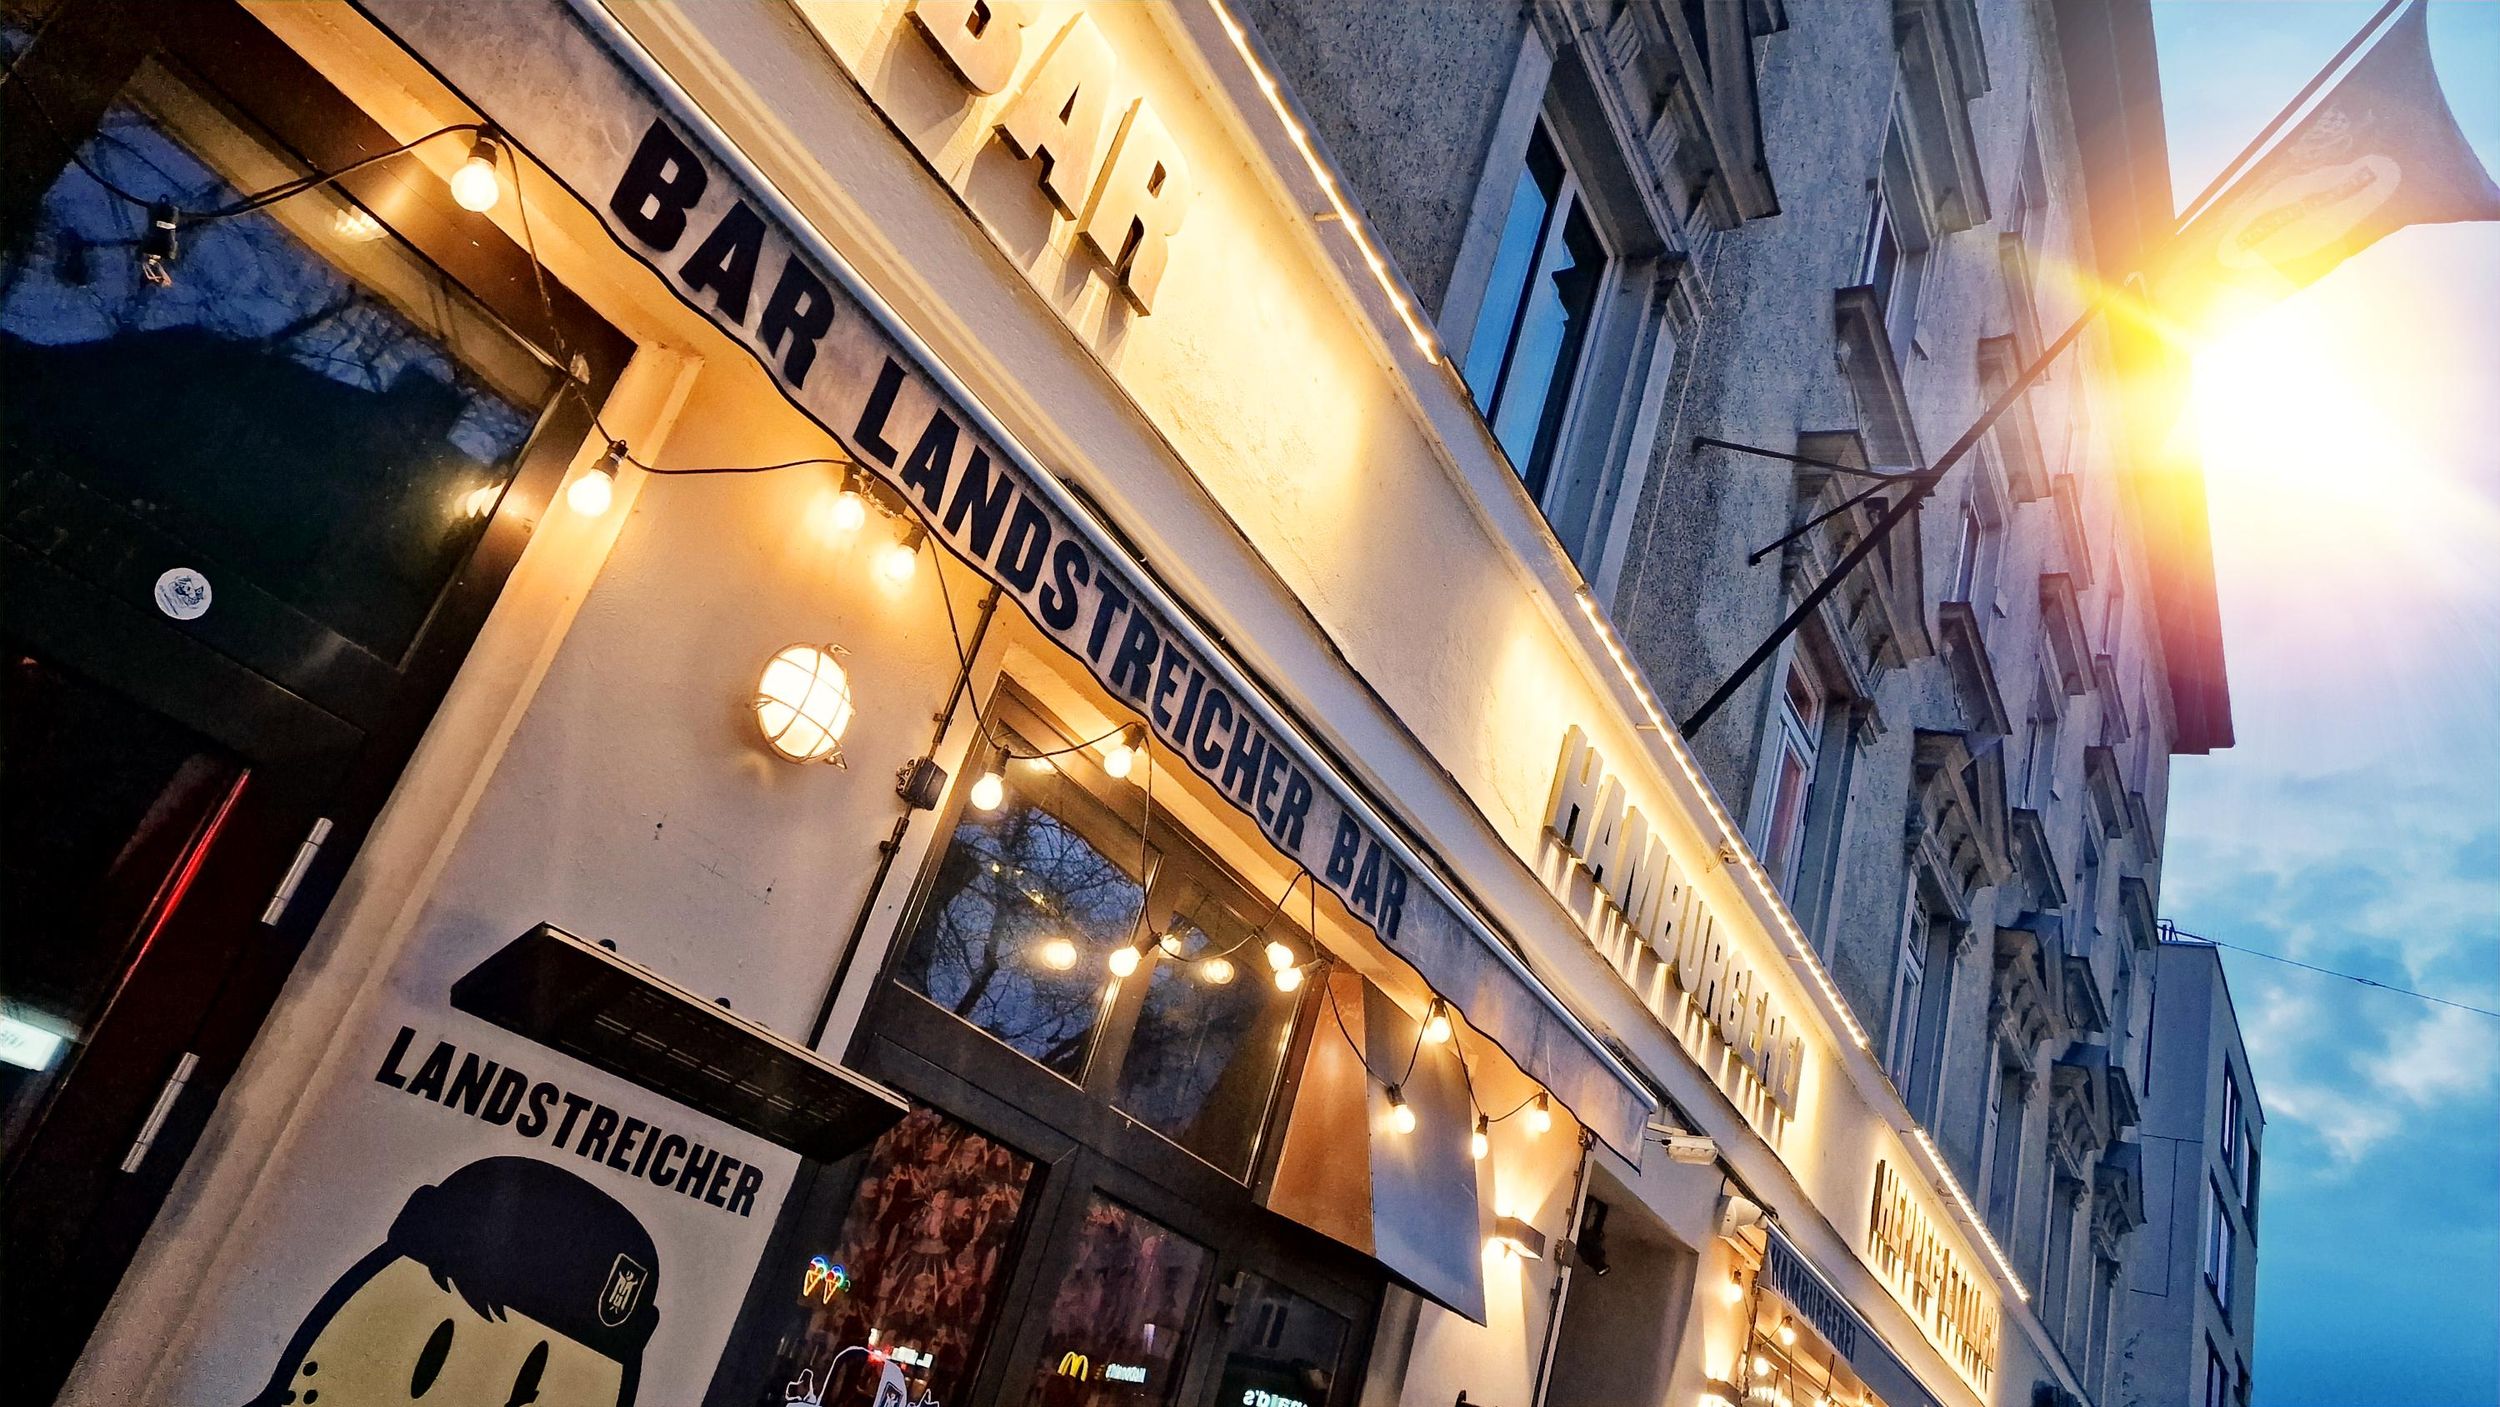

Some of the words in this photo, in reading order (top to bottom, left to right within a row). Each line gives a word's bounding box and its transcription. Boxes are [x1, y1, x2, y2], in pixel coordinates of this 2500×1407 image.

[609, 117, 836, 390] BAR
[853, 356, 1313, 853] LANDSTREICHER
[1327, 811, 1409, 941] BAR
[1543, 724, 1806, 1123] HAMBURGEREI
[374, 1025, 764, 1218] LANDSTREICHER
[1771, 1242, 1856, 1364] HAMBURGEREI
